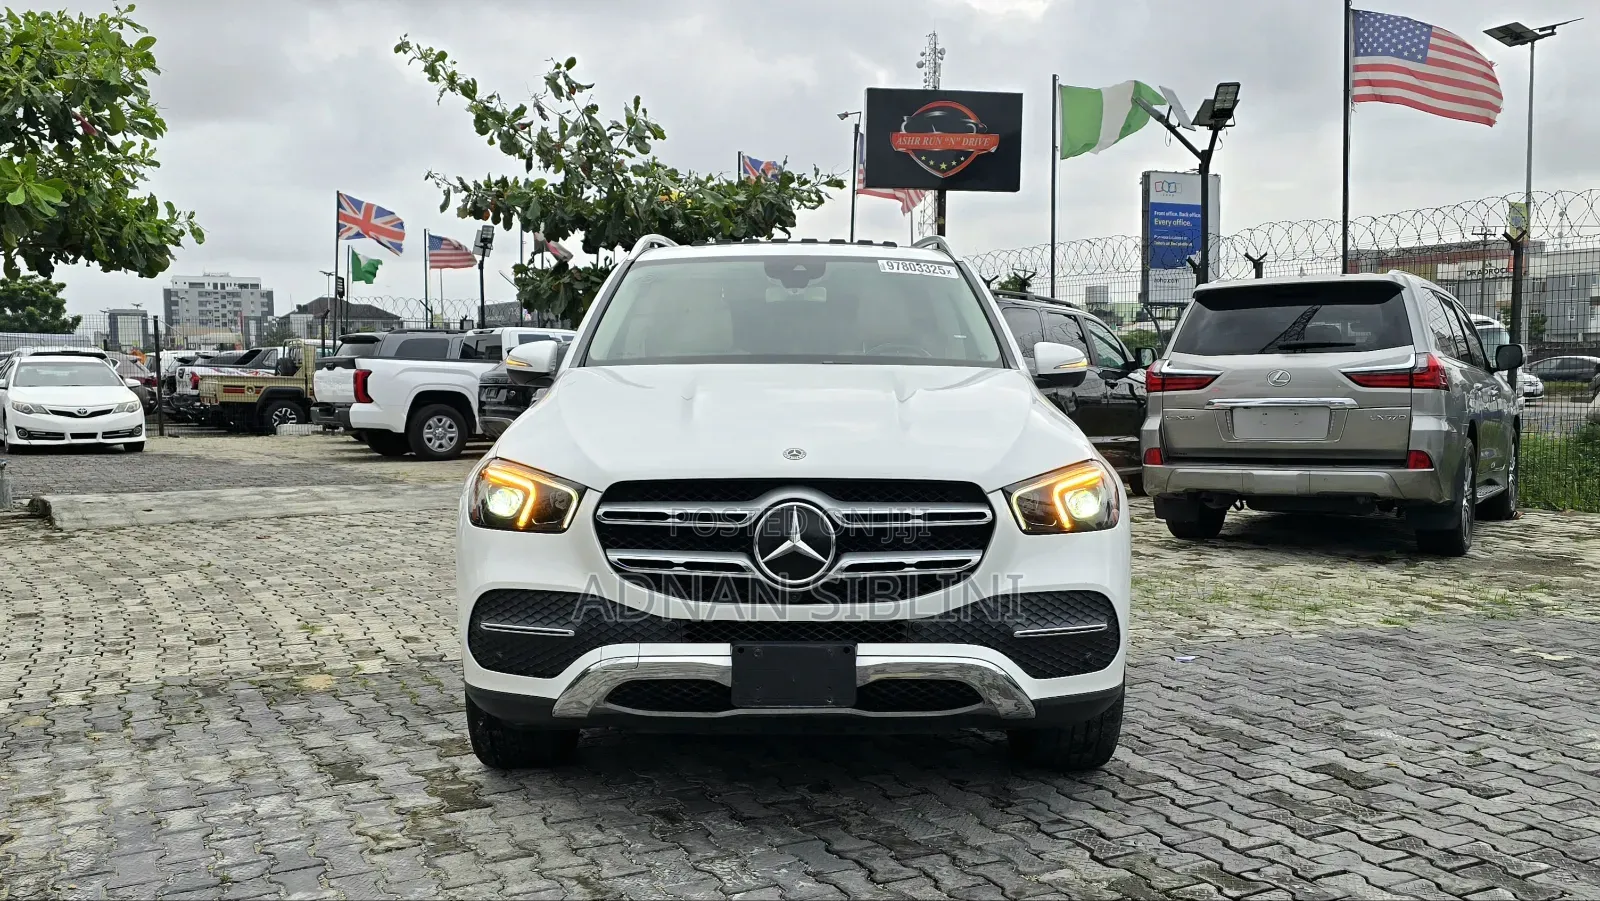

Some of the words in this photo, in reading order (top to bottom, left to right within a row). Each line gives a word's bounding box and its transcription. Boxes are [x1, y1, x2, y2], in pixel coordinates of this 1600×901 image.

[962, 138, 991, 147] DRIVE
[1154, 218, 1172, 227] Every
[1172, 218, 1193, 227] office.
